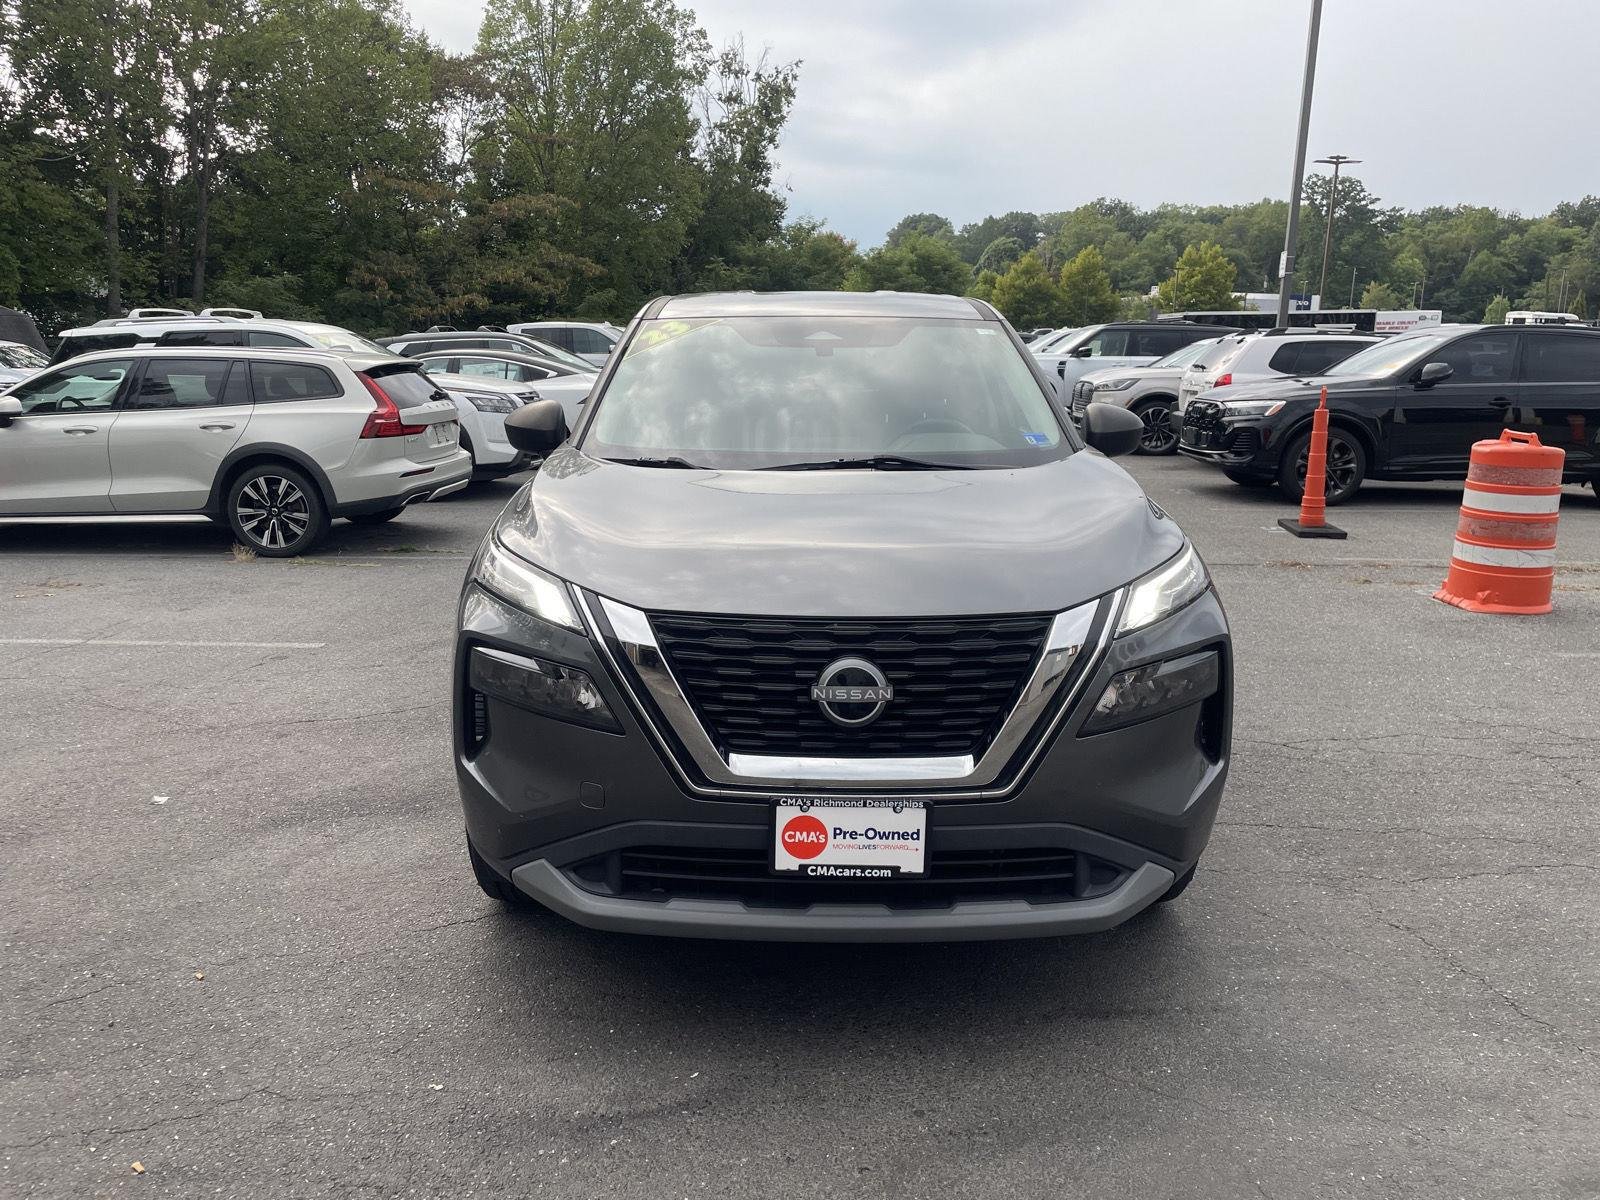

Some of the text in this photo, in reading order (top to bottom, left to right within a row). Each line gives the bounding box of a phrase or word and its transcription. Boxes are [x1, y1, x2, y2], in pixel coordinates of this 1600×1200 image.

[813, 688, 892, 700] NISSAN
[780, 798, 924, 809] CMA's Richmond Dealerships
[784, 831, 826, 843] CMA's
[832, 827, 921, 841] Pre-Owned
[807, 865, 892, 877] CMAcars.com
